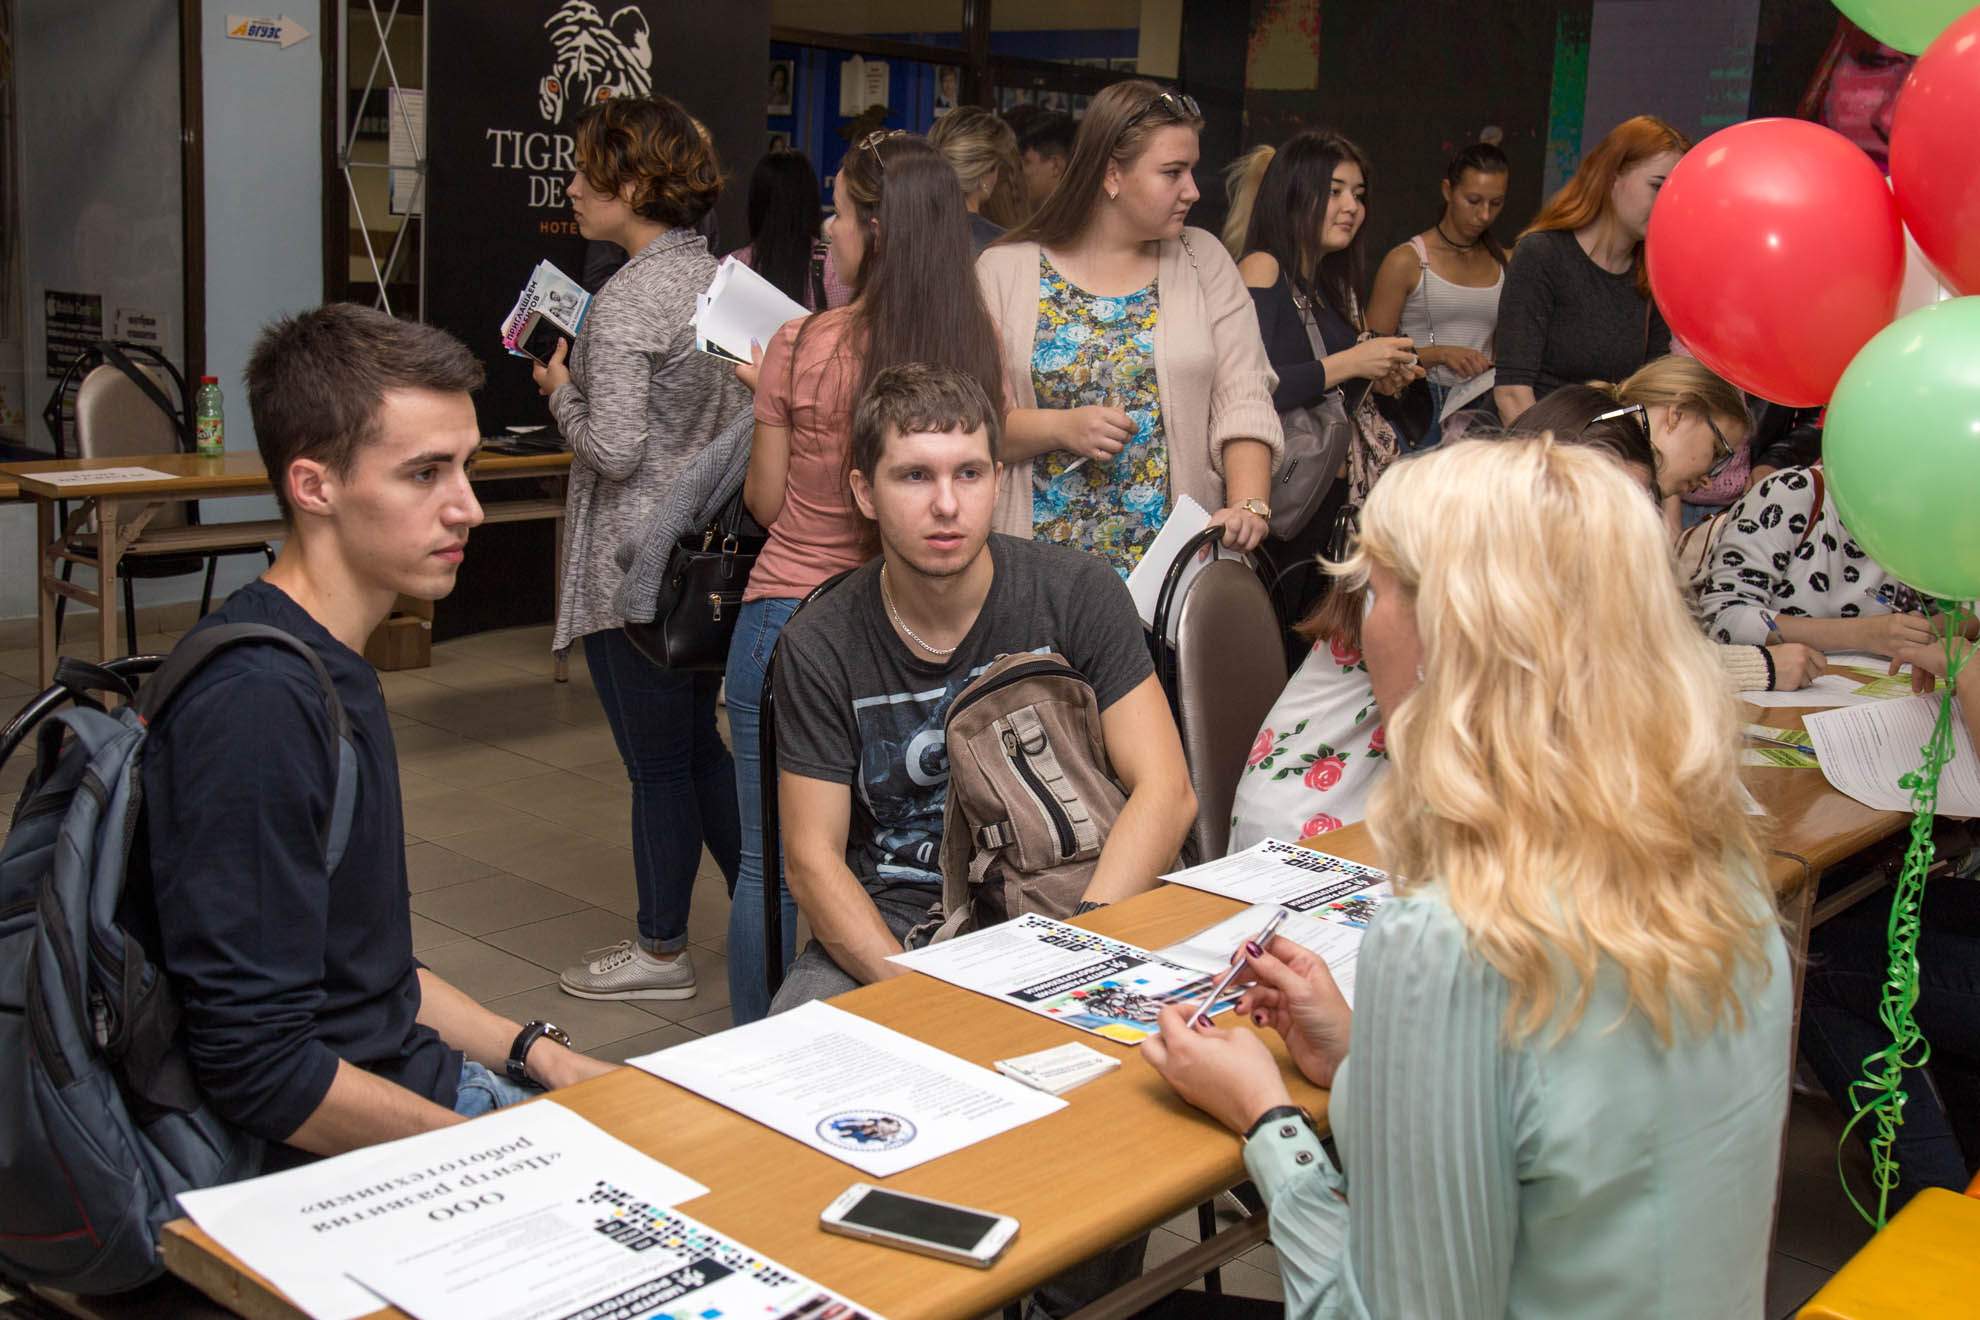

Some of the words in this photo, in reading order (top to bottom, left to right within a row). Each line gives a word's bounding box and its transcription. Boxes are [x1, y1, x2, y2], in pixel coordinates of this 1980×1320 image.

[485, 127, 577, 172] TIGR
[527, 175, 566, 208] DE
[540, 221, 578, 235] HOTE
[507, 280, 538, 340] ПРИГЛАШАЕМ
[313, 1182, 453, 1233] развития
[427, 1191, 505, 1223] ООО
